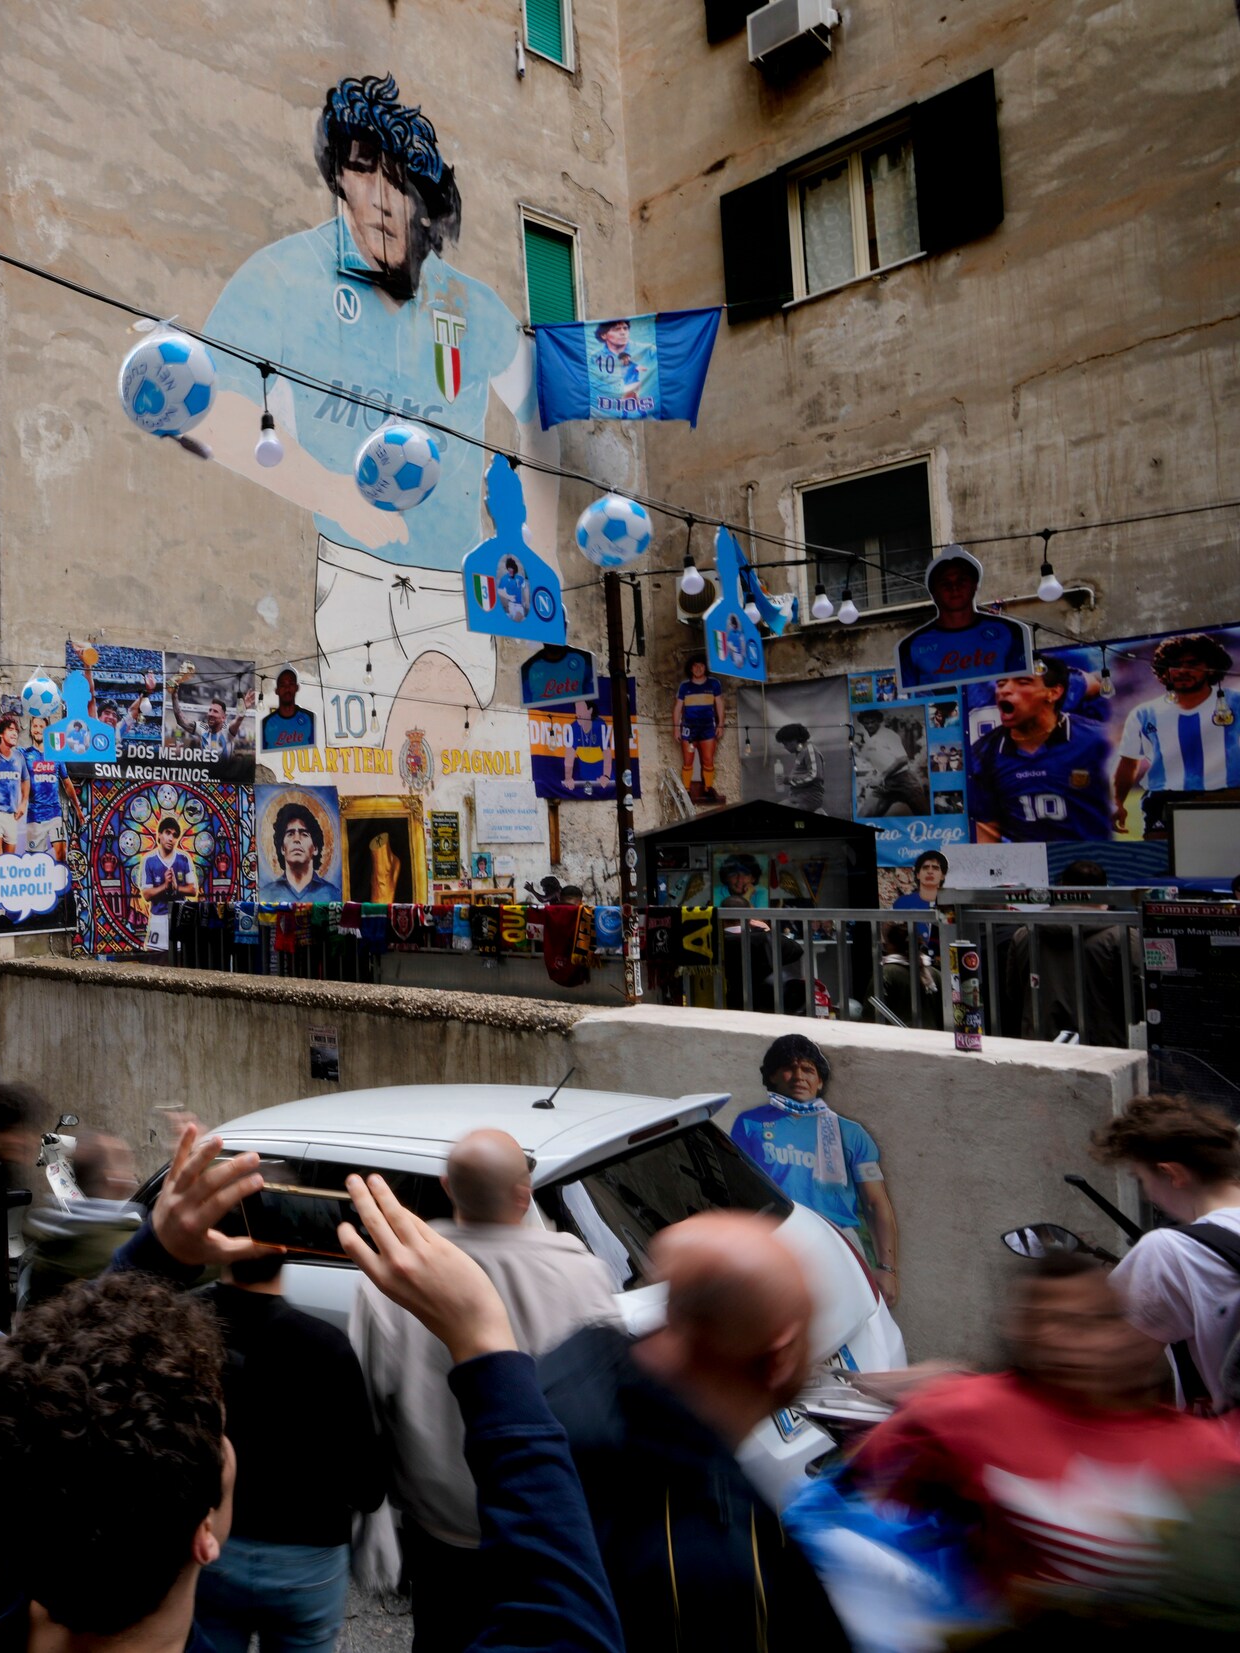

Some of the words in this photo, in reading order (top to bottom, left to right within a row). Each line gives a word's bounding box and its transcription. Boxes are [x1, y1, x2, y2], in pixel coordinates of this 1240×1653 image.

[339, 290, 355, 318] N
[595, 355, 615, 374] 10
[538, 594, 550, 613] N
[933, 648, 1000, 675] Lete
[540, 678, 580, 699] Lete
[331, 694, 367, 739] 10
[274, 731, 304, 746] Lete
[127, 744, 155, 760] DOS
[159, 746, 219, 763] MEJORES
[33, 762, 55, 773] Lete
[94, 764, 122, 778] SON
[281, 749, 394, 781] QUARTIERI
[441, 750, 522, 776] SPAGNOLI
[1015, 769, 1048, 779] adidas
[1018, 793, 1068, 822] 10
[907, 820, 966, 845] Diego
[0, 865, 32, 878] L'Oro
[34, 863, 46, 877] di
[0, 882, 53, 898] NAPOLI!
[502, 904, 527, 943] QUA
[1156, 926, 1185, 937] Largo
[1187, 927, 1238, 937] Maradona
[762, 1141, 817, 1169] Buito
